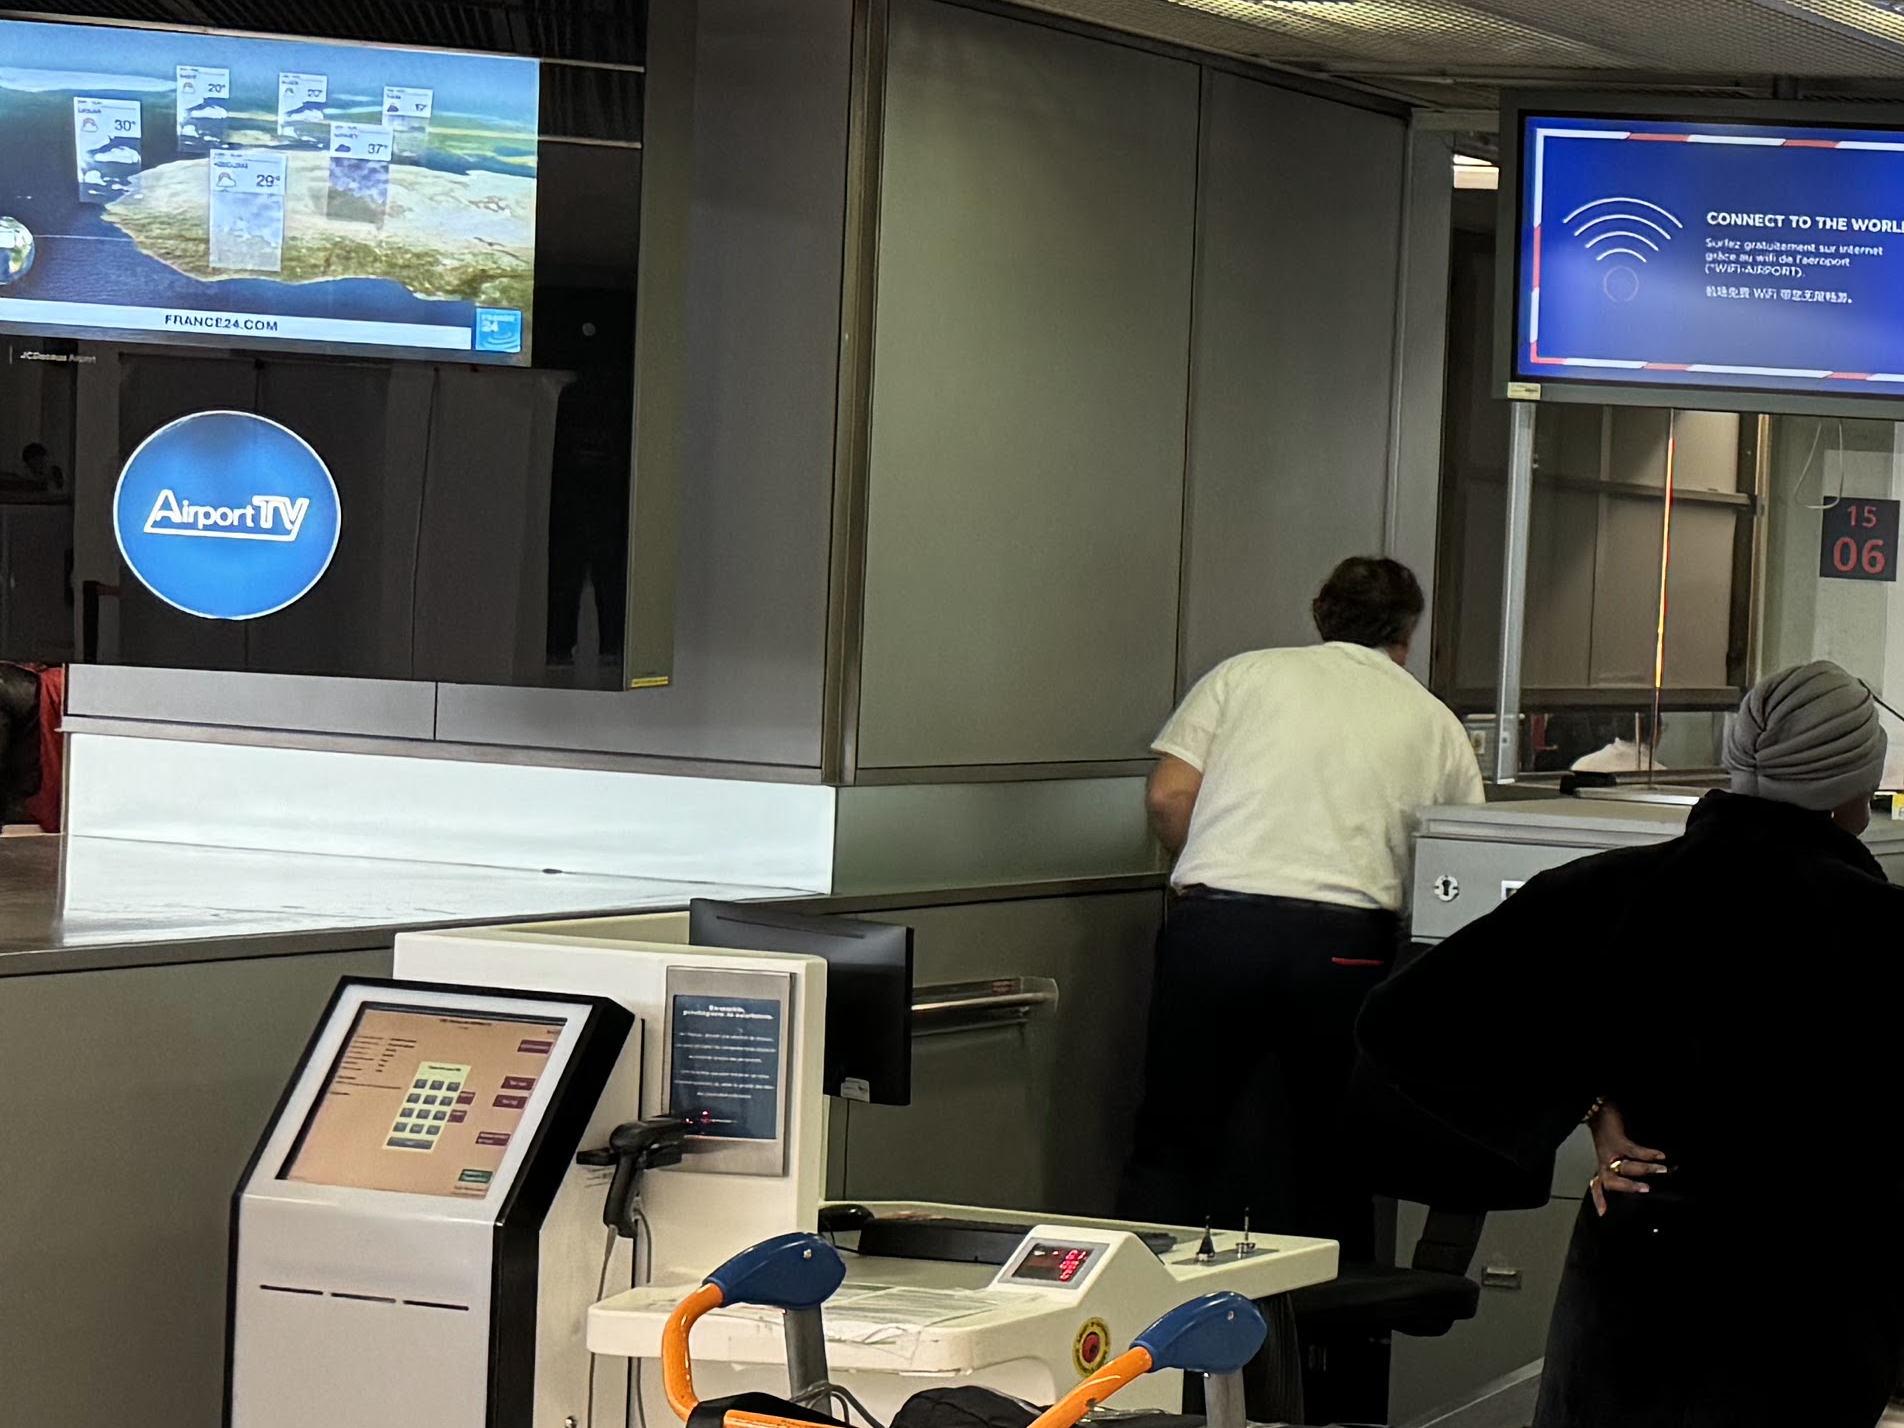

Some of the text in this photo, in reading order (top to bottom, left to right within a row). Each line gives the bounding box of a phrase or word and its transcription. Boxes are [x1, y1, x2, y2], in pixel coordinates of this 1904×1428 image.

[114, 119, 136, 131] 30°
[368, 143, 388, 154] 37°
[1707, 212, 1784, 227] CONNECT
[1789, 216, 1812, 229] TO
[1815, 217, 1848, 230] THE
[164, 313, 279, 333] FRANCE24.COM
[1847, 505, 1877, 527] 15
[1833, 536, 1886, 574] 06
